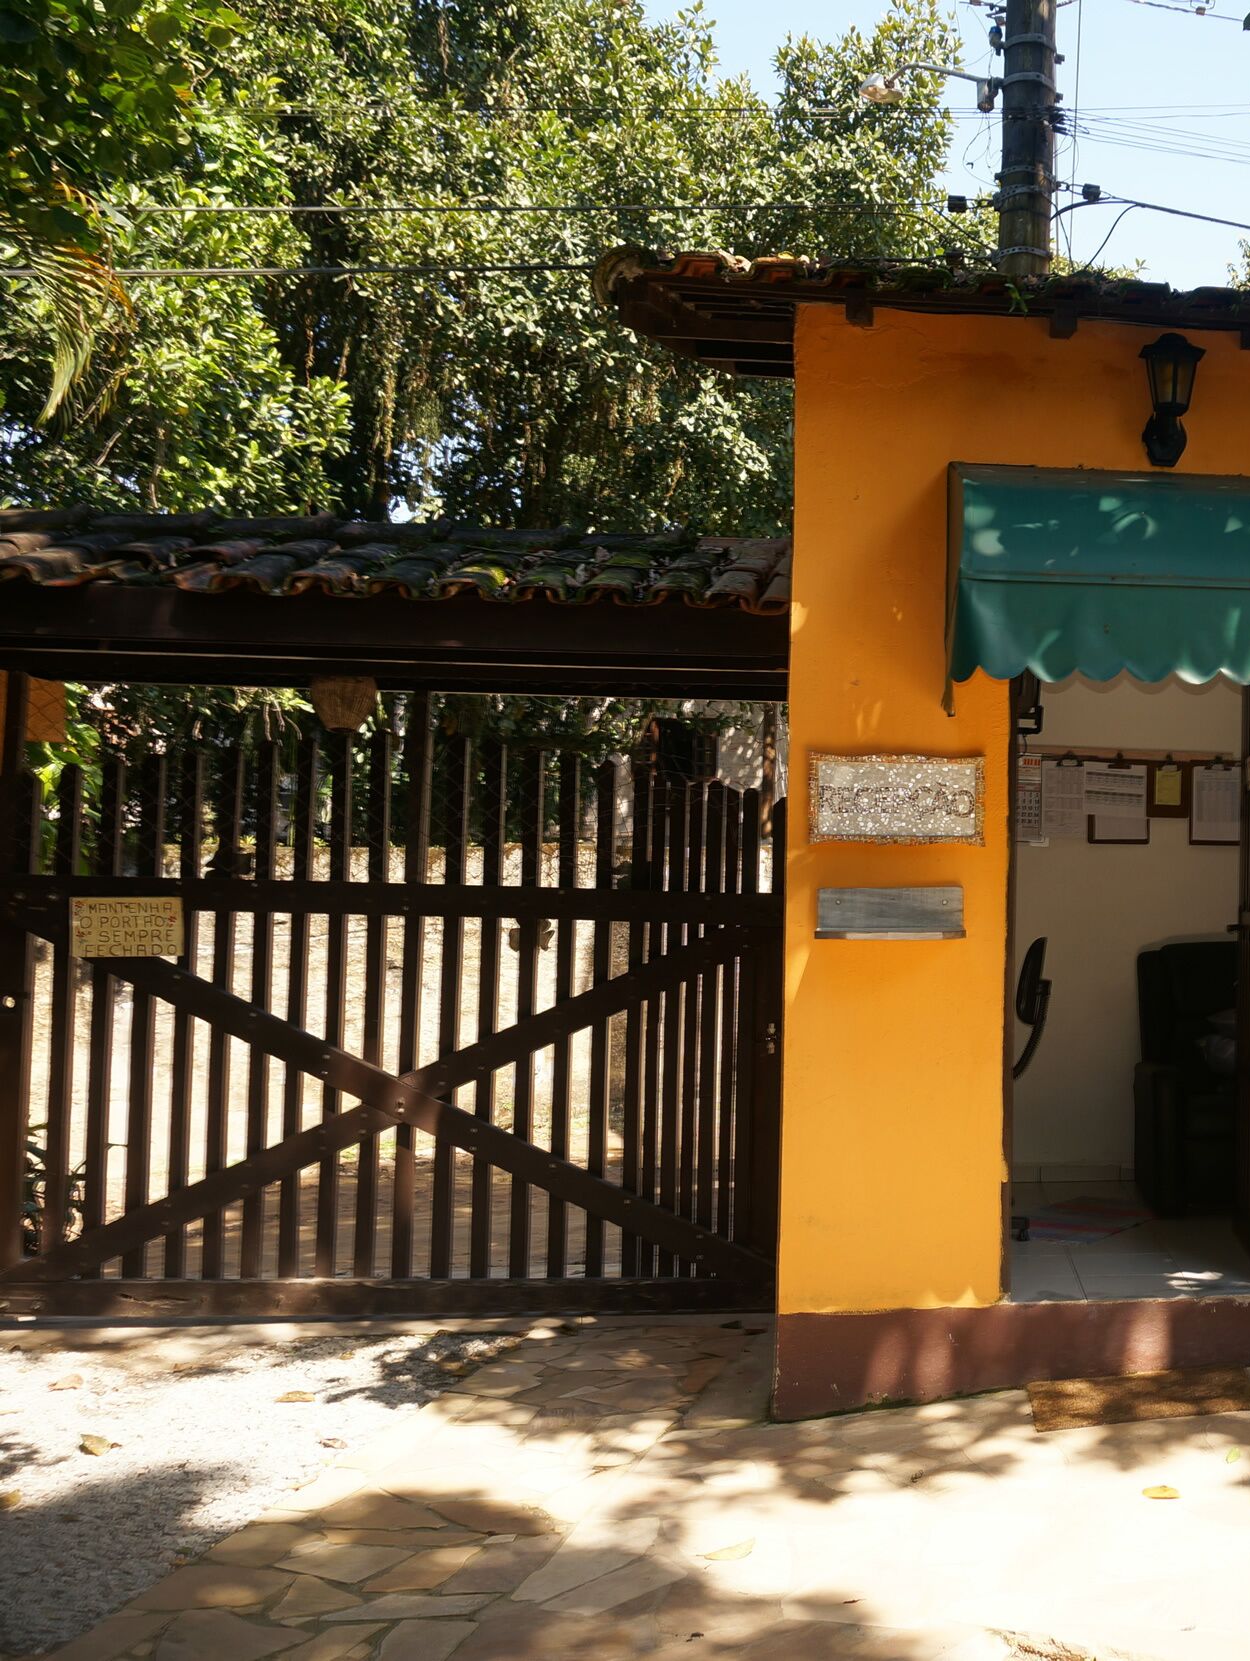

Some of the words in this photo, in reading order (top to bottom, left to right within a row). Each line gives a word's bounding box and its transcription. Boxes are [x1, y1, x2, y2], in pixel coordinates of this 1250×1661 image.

[88, 902, 172, 914] MANTENHA
[79, 915, 93, 929] O
[98, 929, 175, 943] SEMPRE
[85, 943, 177, 957] FECHADO
